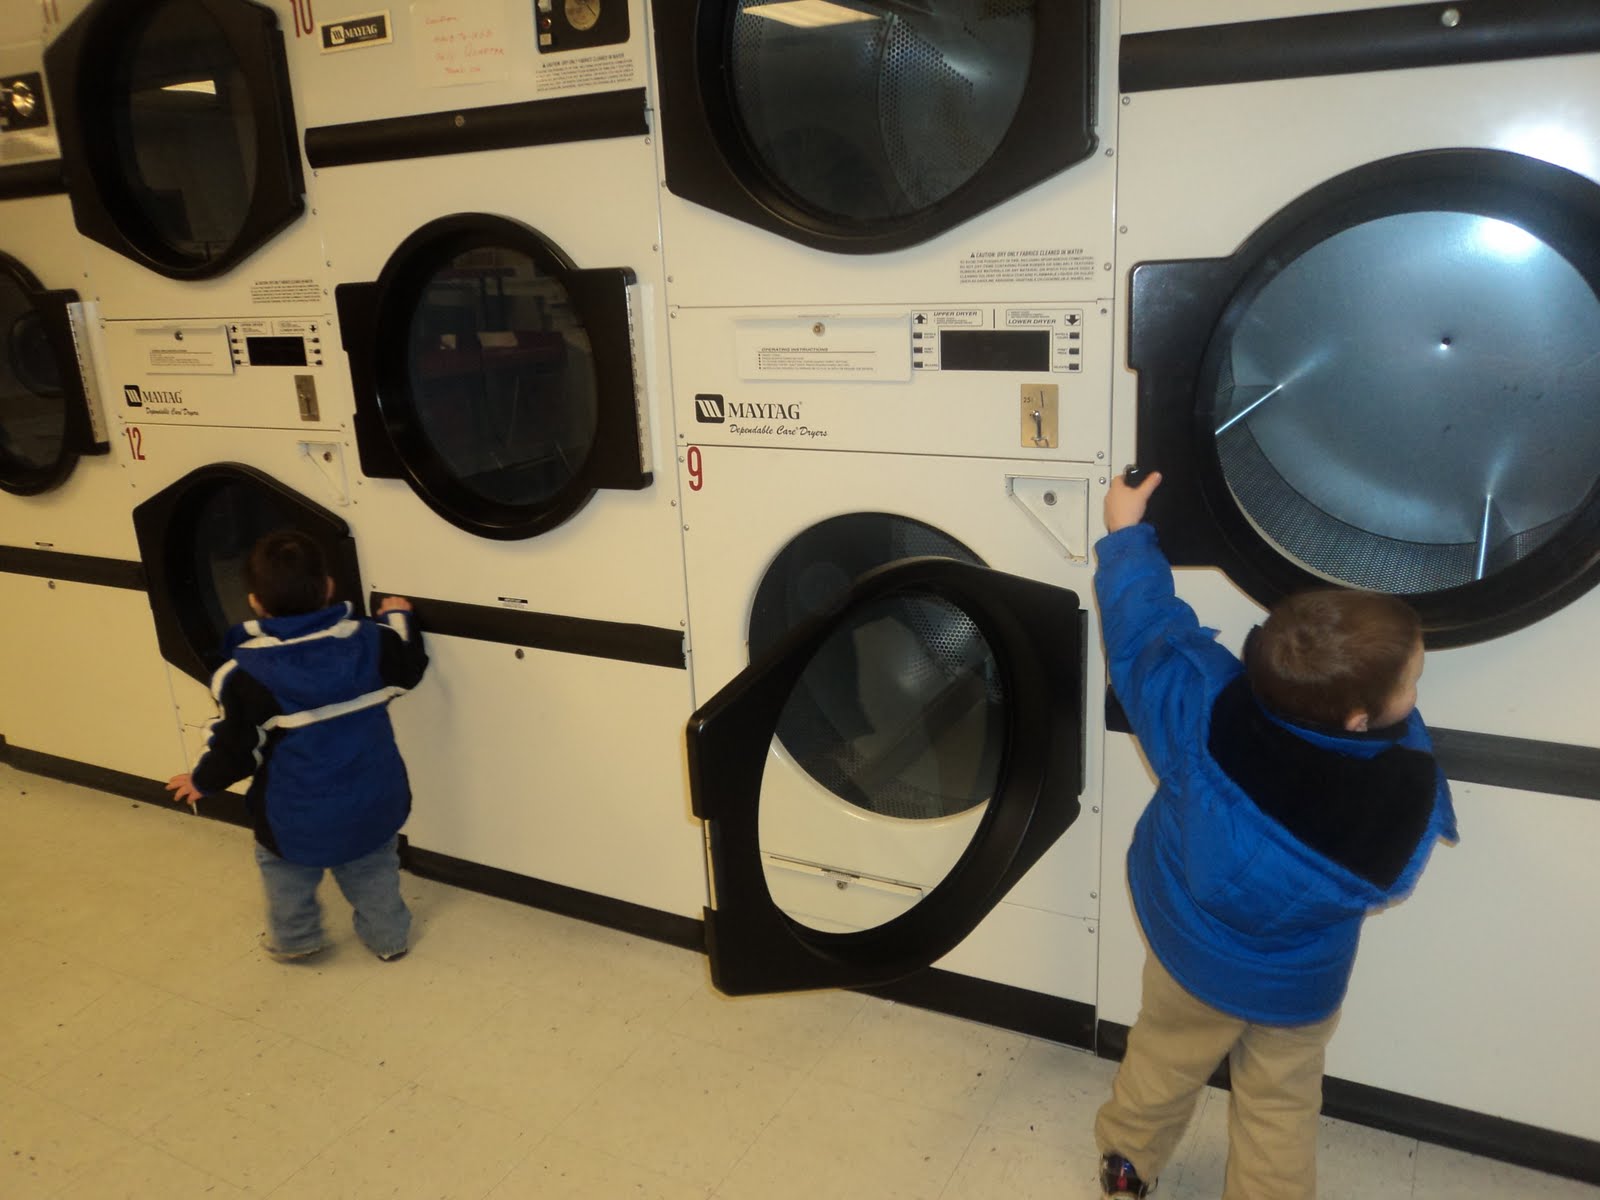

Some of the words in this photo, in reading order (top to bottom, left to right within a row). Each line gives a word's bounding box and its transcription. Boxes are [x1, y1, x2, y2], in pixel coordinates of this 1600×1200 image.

[289, 0, 314, 38] 10
[344, 24, 378, 39] MAYTAG
[143, 391, 182, 404] MAYTAG
[728, 402, 800, 420] MAYTAG
[729, 423, 773, 436] Dependable
[800, 426, 828, 439] Dryers
[126, 427, 146, 461] 12
[687, 446, 703, 491] 9
